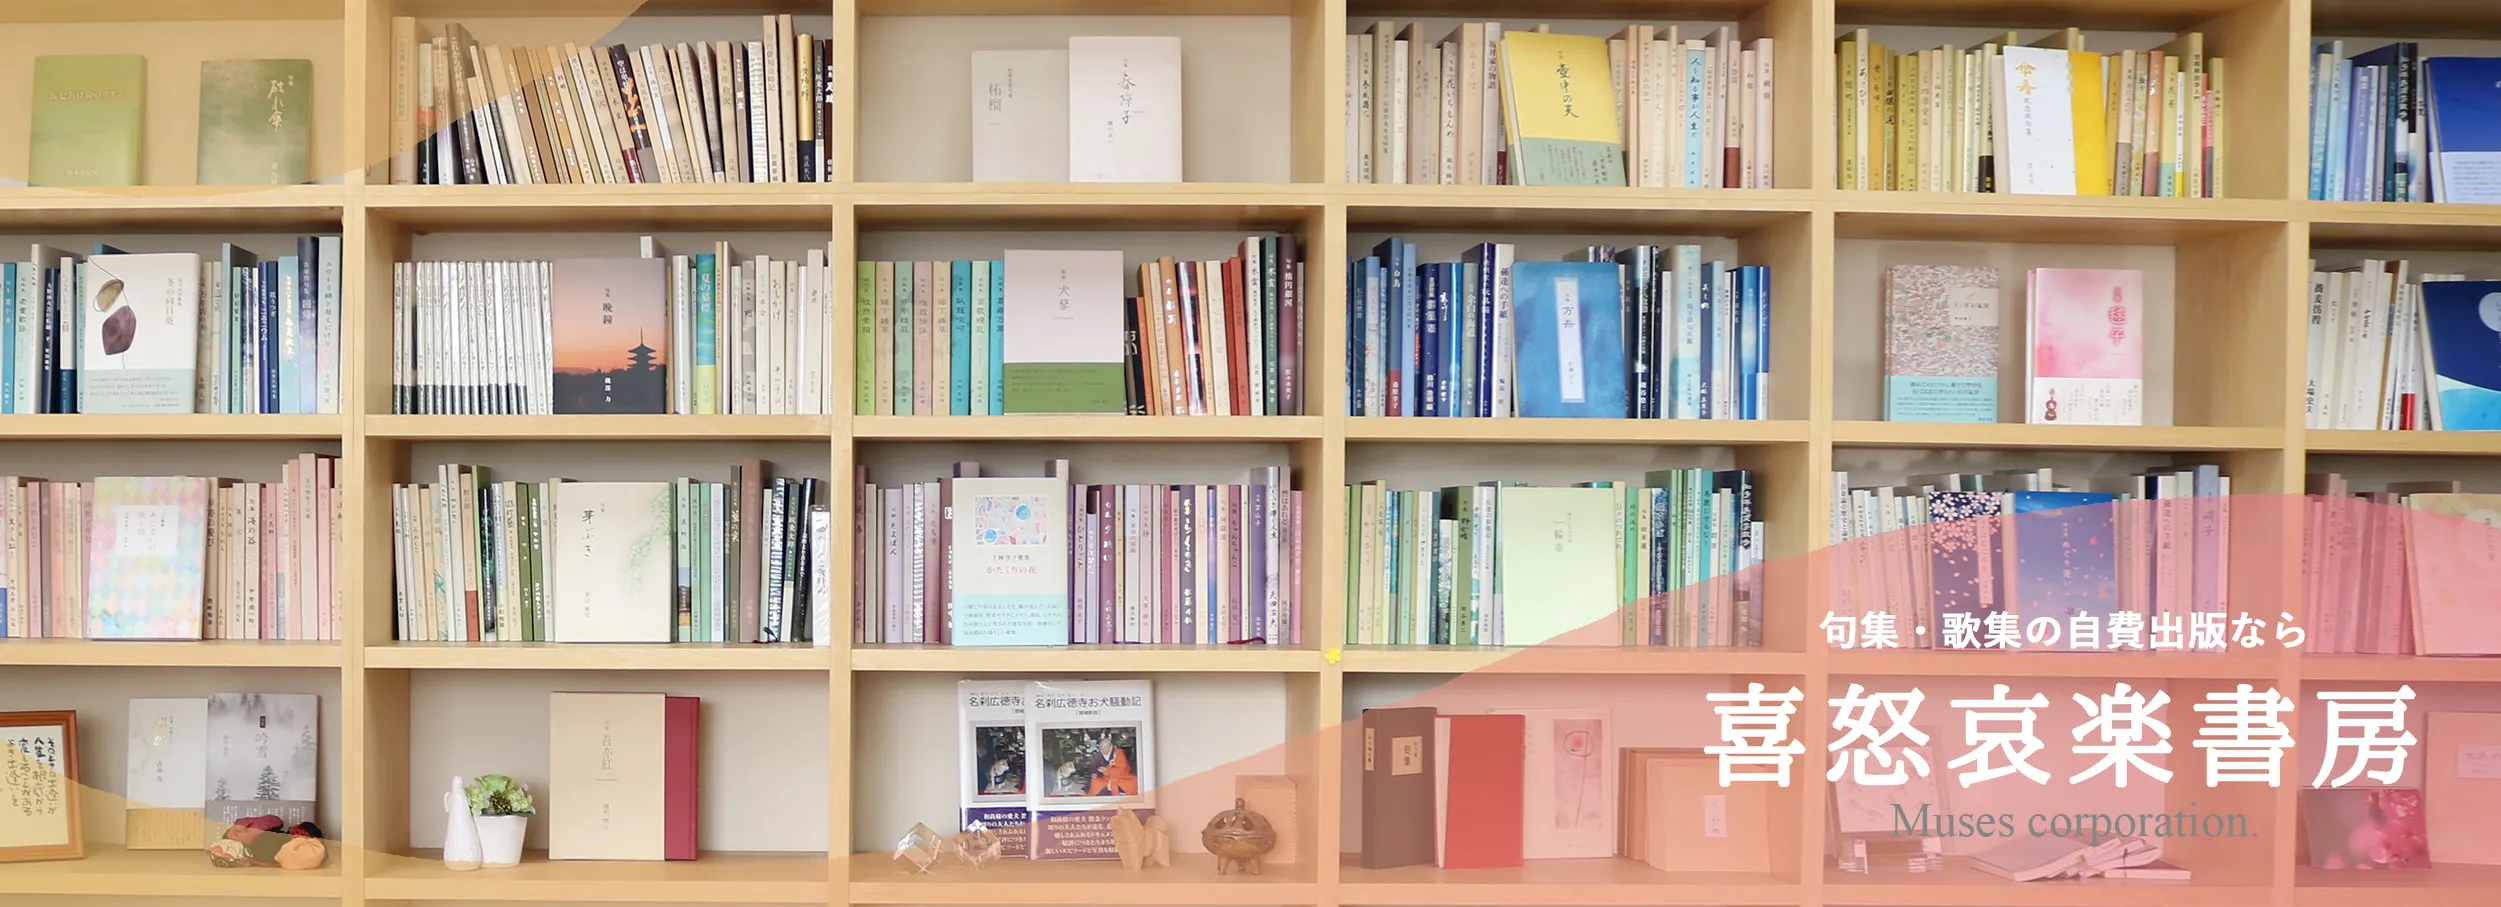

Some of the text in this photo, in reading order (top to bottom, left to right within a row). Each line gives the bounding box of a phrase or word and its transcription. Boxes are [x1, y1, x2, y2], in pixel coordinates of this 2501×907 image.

[988, 82, 1002, 112] 柘榴
[1118, 73, 1136, 124] 春障子
[1058, 284, 1070, 311] 犬蓼
[603, 302, 613, 325] 晩鐘
[582, 509, 595, 558] 芽ぶき
[986, 565, 1037, 575] かたくりの花
[601, 734, 613, 771] 吾亦紅
